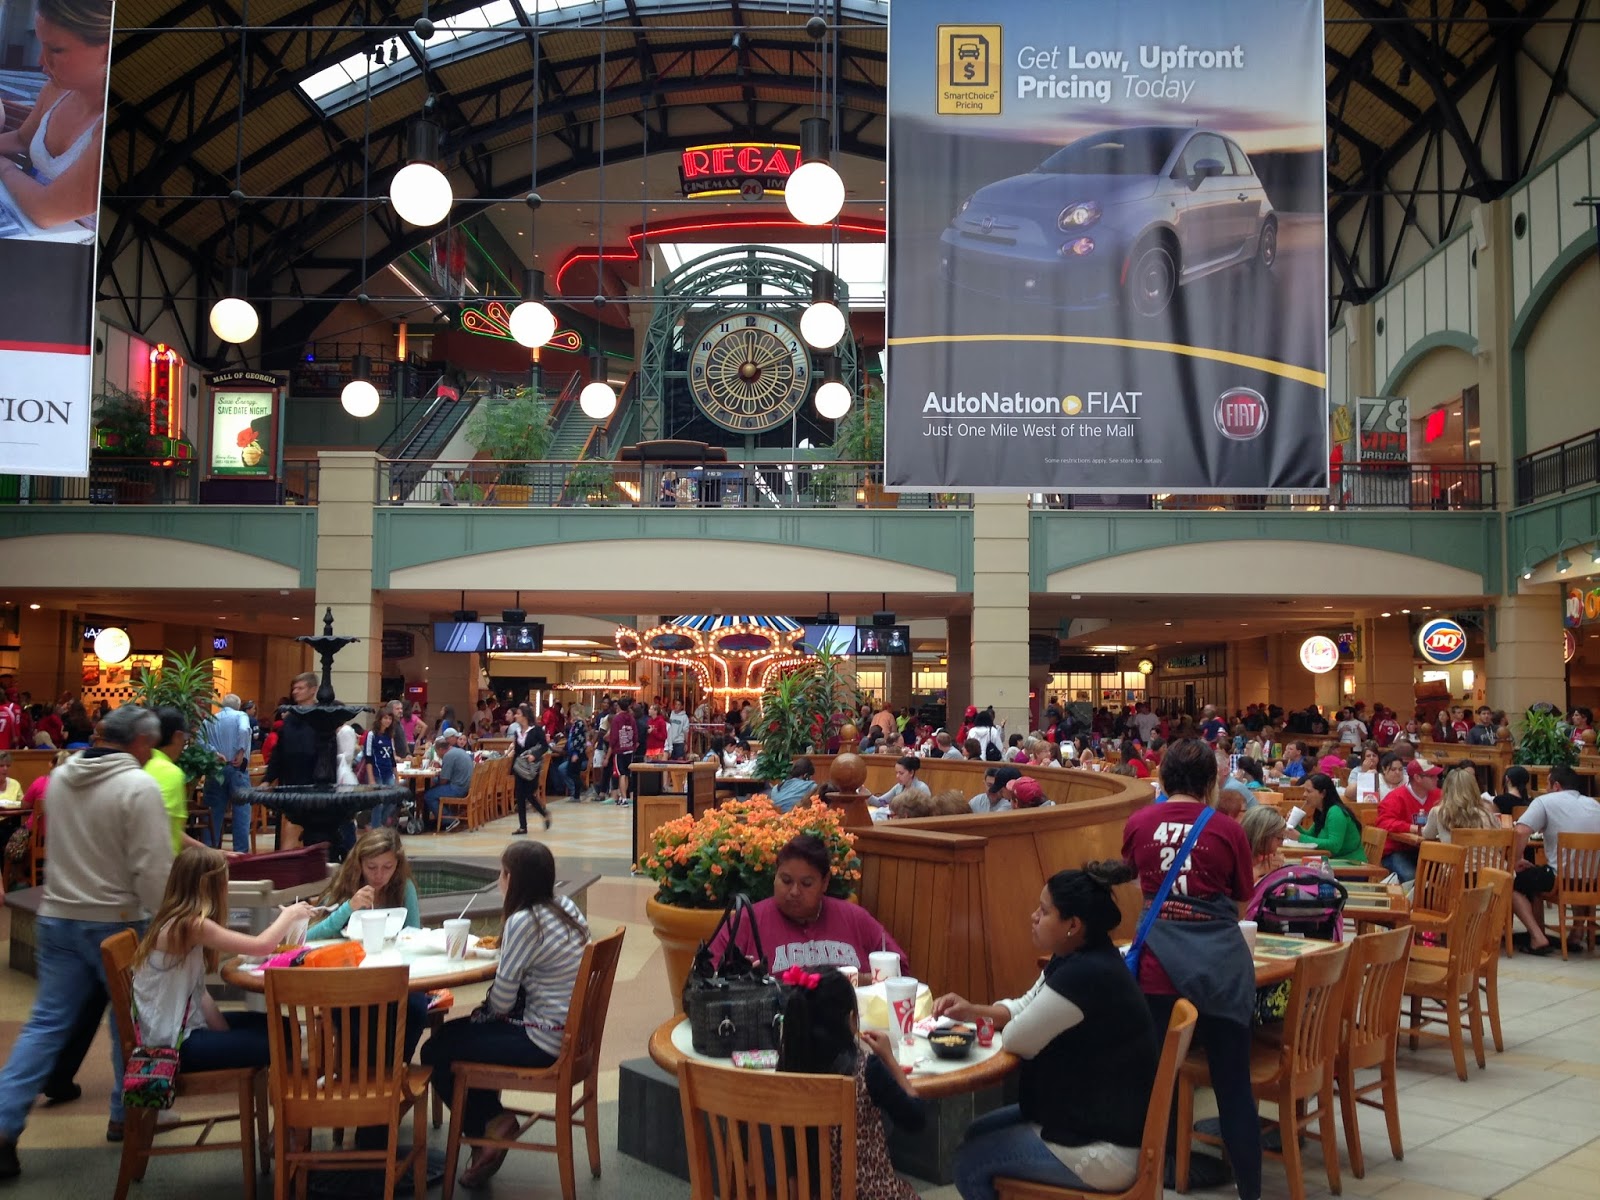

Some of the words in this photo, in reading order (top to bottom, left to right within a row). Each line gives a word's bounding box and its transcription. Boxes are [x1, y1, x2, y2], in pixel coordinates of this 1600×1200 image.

[1017, 46, 1061, 70] Get
[1068, 46, 1129, 72] Low,
[1139, 45, 1244, 73] Upfront
[1017, 75, 1112, 104] Pricing
[1123, 75, 1195, 103] Today
[955, 101, 983, 110] Pricing
[683, 178, 740, 193] CINEMAS
[742, 184, 761, 195] 20
[745, 316, 756, 327] 12
[720, 323, 729, 333] 11
[774, 324, 778, 333] 1
[701, 341, 712, 351] 10
[790, 341, 798, 352] 2
[695, 366, 703, 377] 9
[798, 366, 804, 377] 3
[212, 373, 233, 384] MALL
[245, 372, 276, 384] GEORGIA
[922, 392, 1060, 414] AutoNation
[1087, 392, 1143, 414] FIAT
[217, 407, 232, 415] SAVE
[233, 406, 248, 415] DATE
[1226, 403, 1257, 427] FIAT
[745, 417, 753, 428] 6
[923, 424, 954, 437] Just
[957, 423, 987, 437] One
[990, 423, 1019, 437] Mile
[1022, 424, 1057, 437] West
[1060, 424, 1075, 437] of
[1079, 424, 1102, 437] the
[1106, 424, 1135, 437] Mall
[1432, 634, 1457, 649] DQ
[1387, 727, 1394, 736] 3
